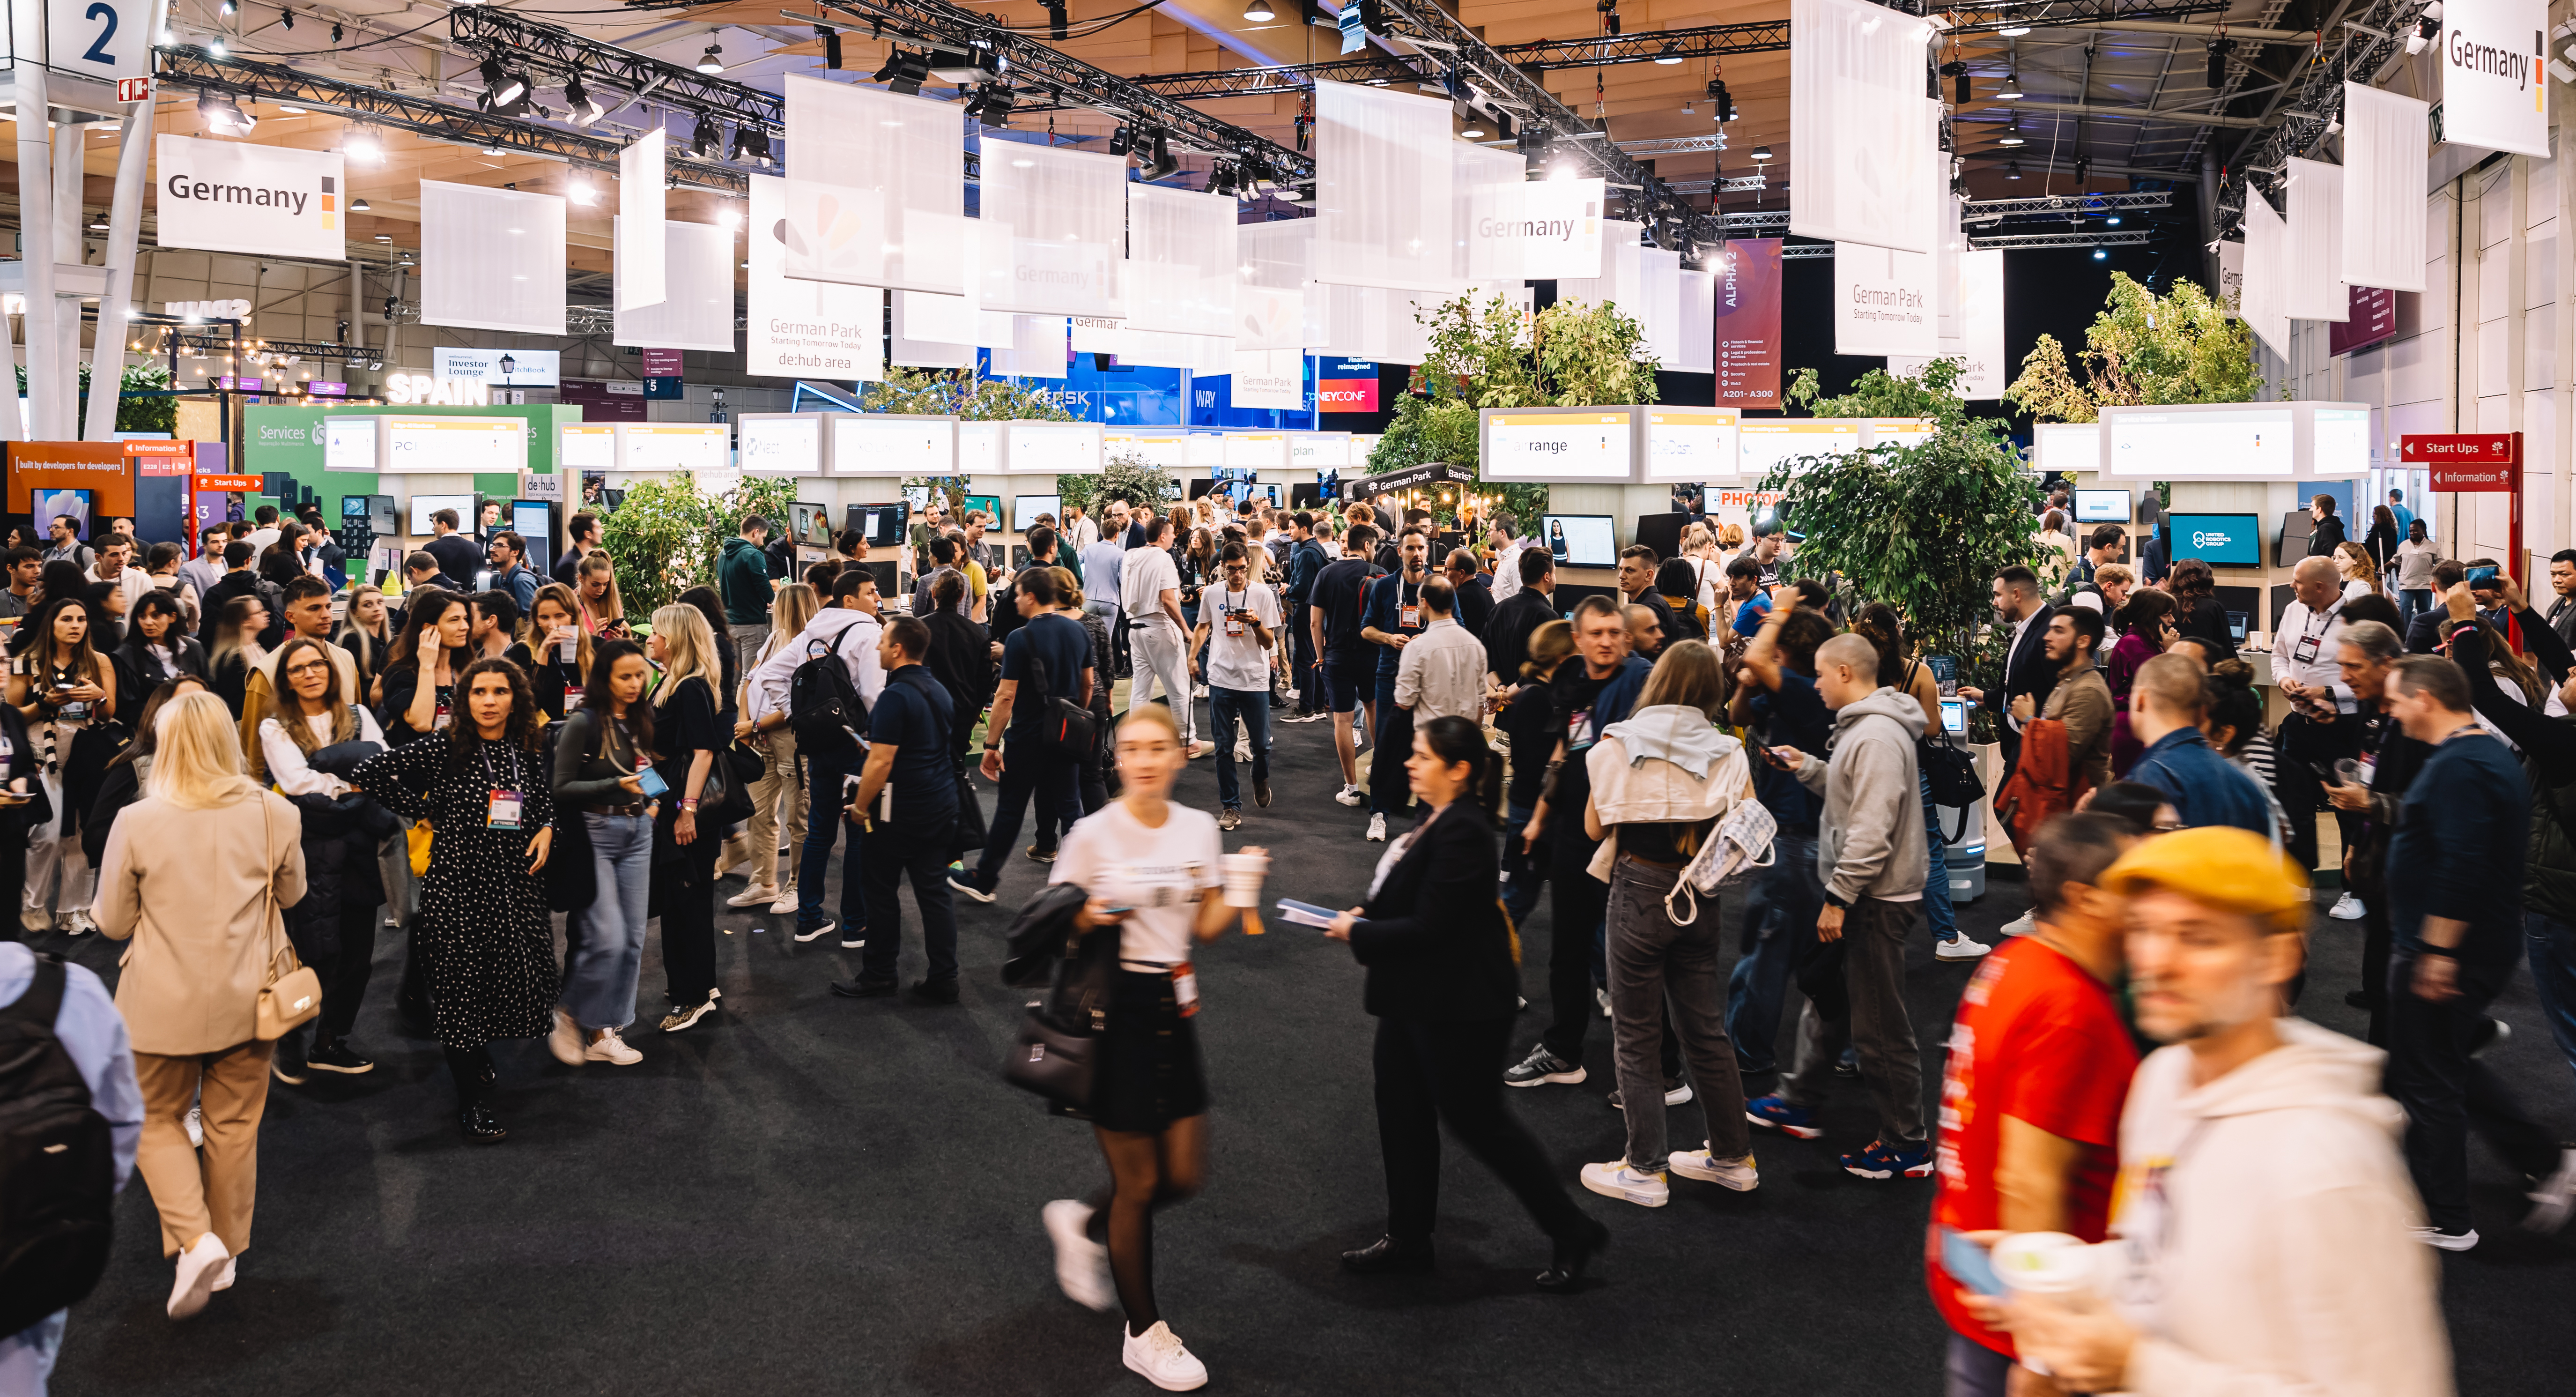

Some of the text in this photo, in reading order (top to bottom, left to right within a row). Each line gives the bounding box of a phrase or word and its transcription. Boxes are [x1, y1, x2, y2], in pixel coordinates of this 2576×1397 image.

[82, 2, 118, 66] 2
[2450, 30, 2529, 91] Germany
[168, 175, 308, 216] Germany
[1478, 215, 1575, 241] Germany
[1015, 264, 1089, 290] Germany
[1725, 252, 1737, 307] ALPHA 2
[2222, 267, 2243, 286] Germa
[1853, 284, 1923, 308] German Park
[1854, 309, 1922, 325] Starting Tomorrow Today
[771, 319, 862, 339] German Park
[771, 336, 861, 350] Starting Tomorrow Today
[779, 353, 851, 368] de:hub area
[449, 368, 483, 377] Lounge
[386, 373, 488, 406] SPAIN
[650, 381, 656, 392] 5
[1243, 376, 1291, 387] German Park
[1195, 390, 1215, 408] WAY
[258, 425, 305, 439] iServices
[1293, 445, 1314, 457] plan
[2426, 443, 2479, 455] Start Ups
[20, 460, 33, 469] built
[35, 461, 42, 471] by
[43, 461, 75, 471] developers
[77, 461, 86, 470] for
[87, 462, 121, 472] developers
[700, 470, 722, 478] de:hub
[528, 476, 555, 491] de:hub
[1380, 469, 1473, 490] German Park Barist
[2445, 472, 2496, 482] Information
